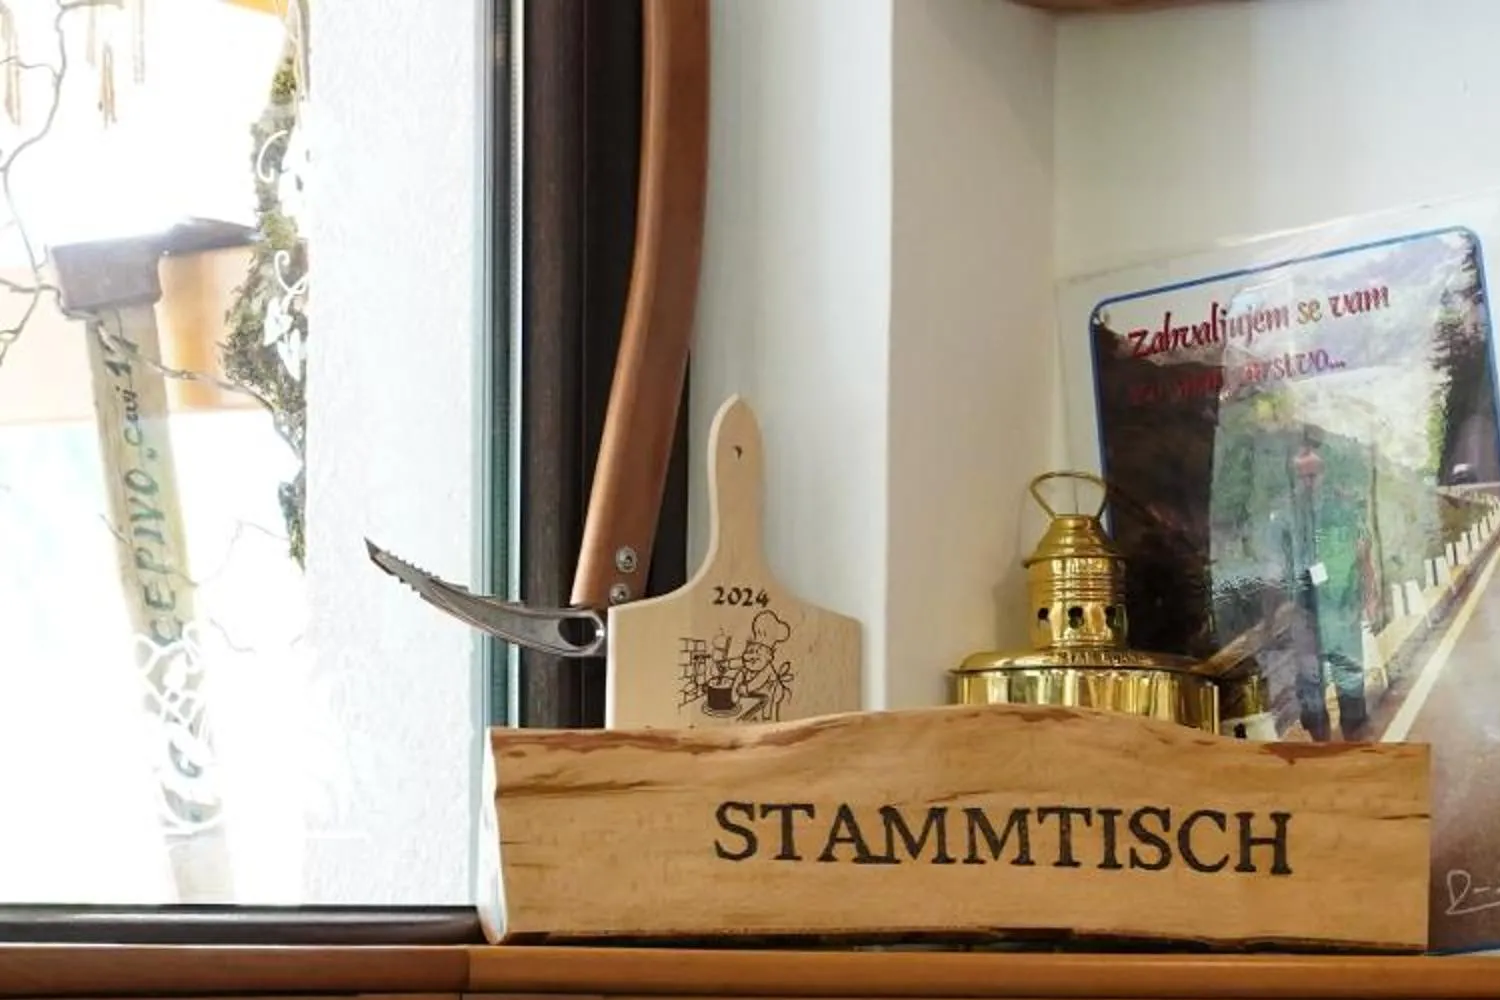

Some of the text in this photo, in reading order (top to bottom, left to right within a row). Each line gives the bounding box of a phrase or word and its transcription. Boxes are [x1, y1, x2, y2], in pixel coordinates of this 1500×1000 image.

[1296, 299, 1322, 324] se
[1327, 285, 1389, 318] vam
[712, 586, 771, 608] 2024
[714, 800, 1293, 877] STAMMTISCH
